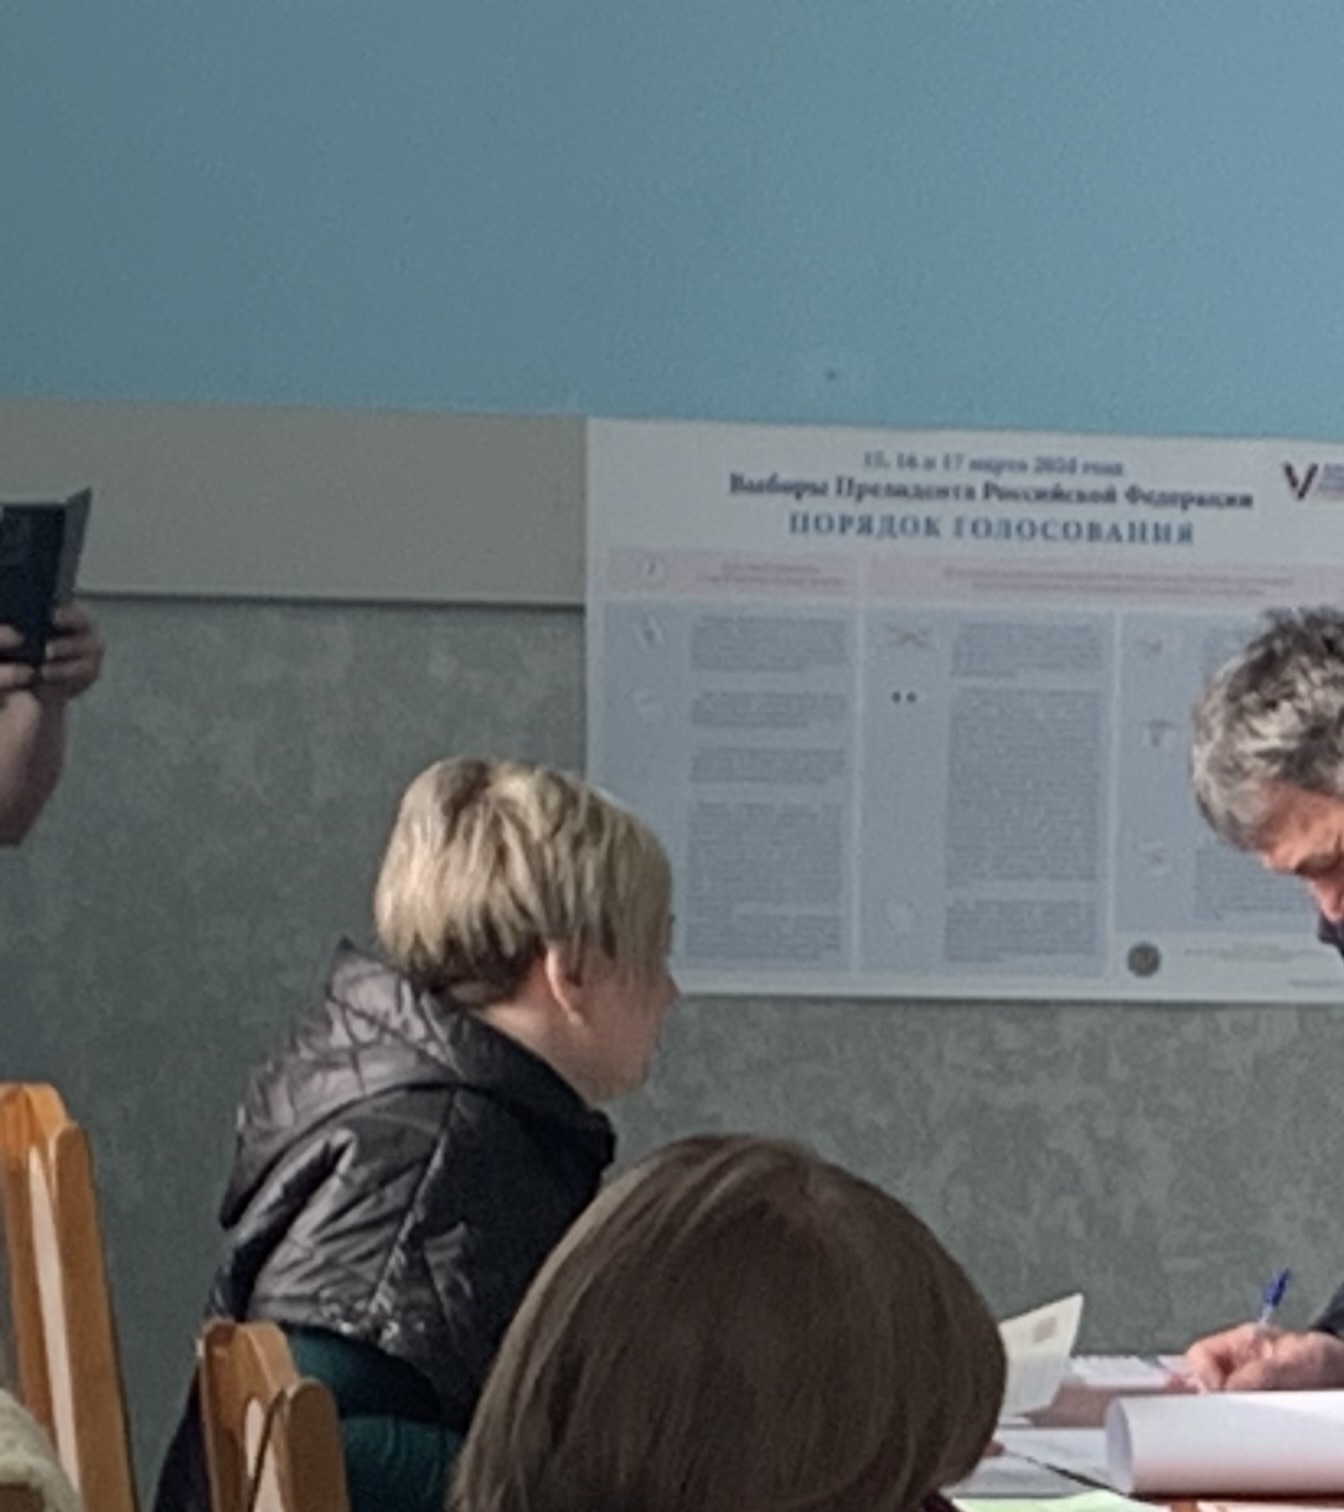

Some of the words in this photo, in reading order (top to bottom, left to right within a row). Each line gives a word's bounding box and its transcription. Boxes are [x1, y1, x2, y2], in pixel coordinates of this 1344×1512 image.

[730, 472, 829, 501] Выборы
[836, 476, 976, 503] Президента
[982, 480, 1118, 505] Российской
[1124, 483, 1253, 512] Федерации
[789, 511, 942, 540] ПОРЯДОК
[953, 516, 1194, 546] ГОЛОСОВАНИЯ
